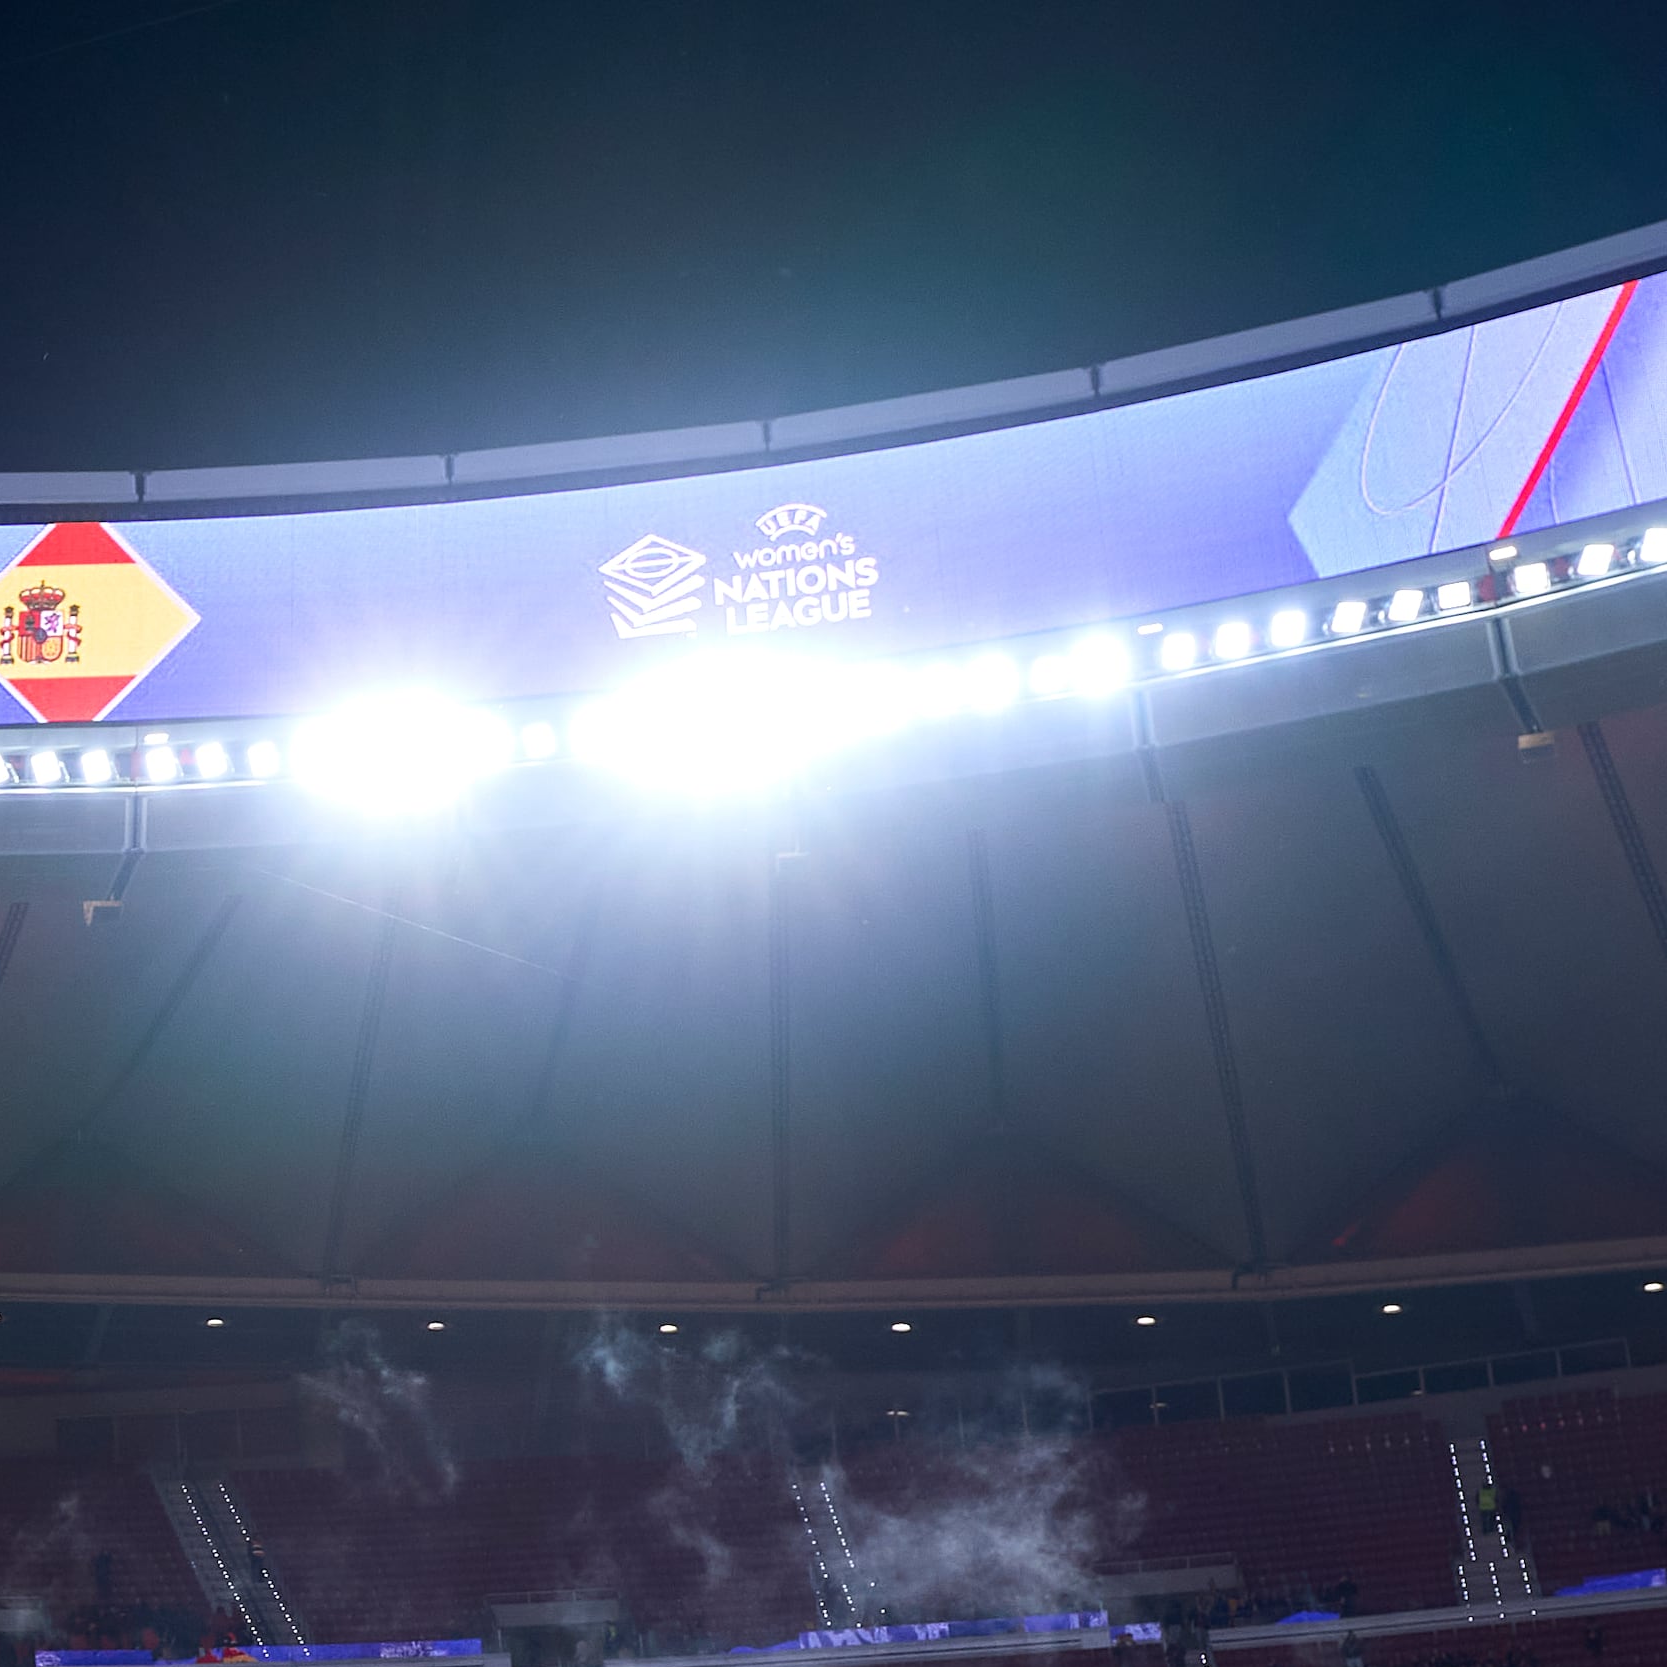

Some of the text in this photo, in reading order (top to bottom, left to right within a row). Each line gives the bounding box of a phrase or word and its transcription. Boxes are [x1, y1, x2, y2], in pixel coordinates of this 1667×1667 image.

[758, 508, 821, 533] UEFA
[733, 531, 856, 569] women's
[713, 556, 879, 606] NATIONS
[726, 590, 873, 636] LEAGUE
